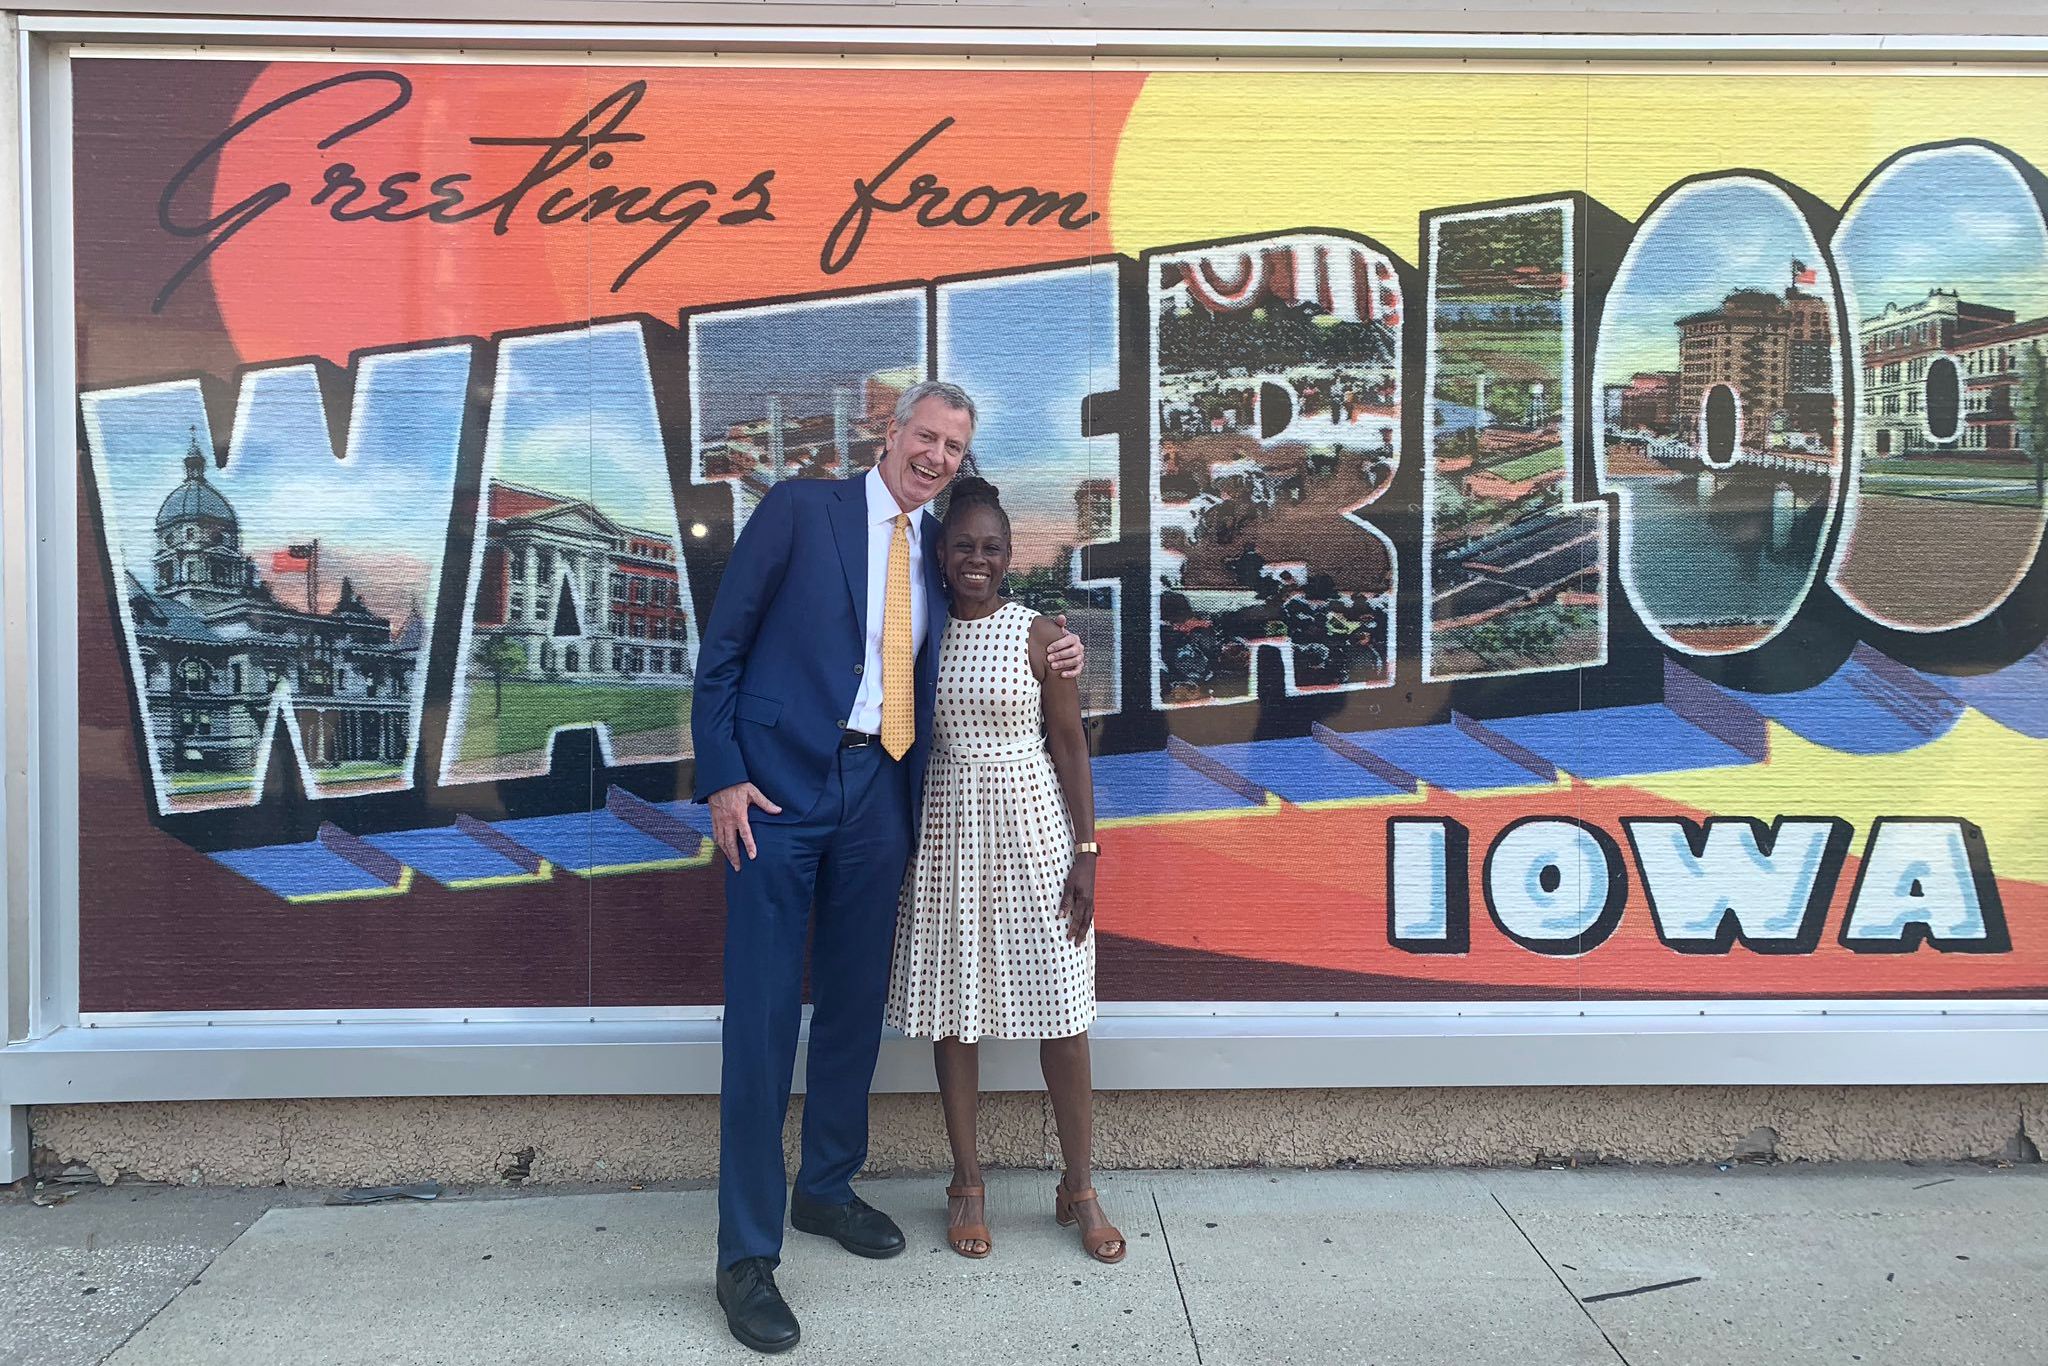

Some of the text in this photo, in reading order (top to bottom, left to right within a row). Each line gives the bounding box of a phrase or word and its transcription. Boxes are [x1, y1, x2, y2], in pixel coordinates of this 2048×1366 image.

[150, 69, 1100, 313] Greetings from
[1386, 815, 2013, 954] IOWA
